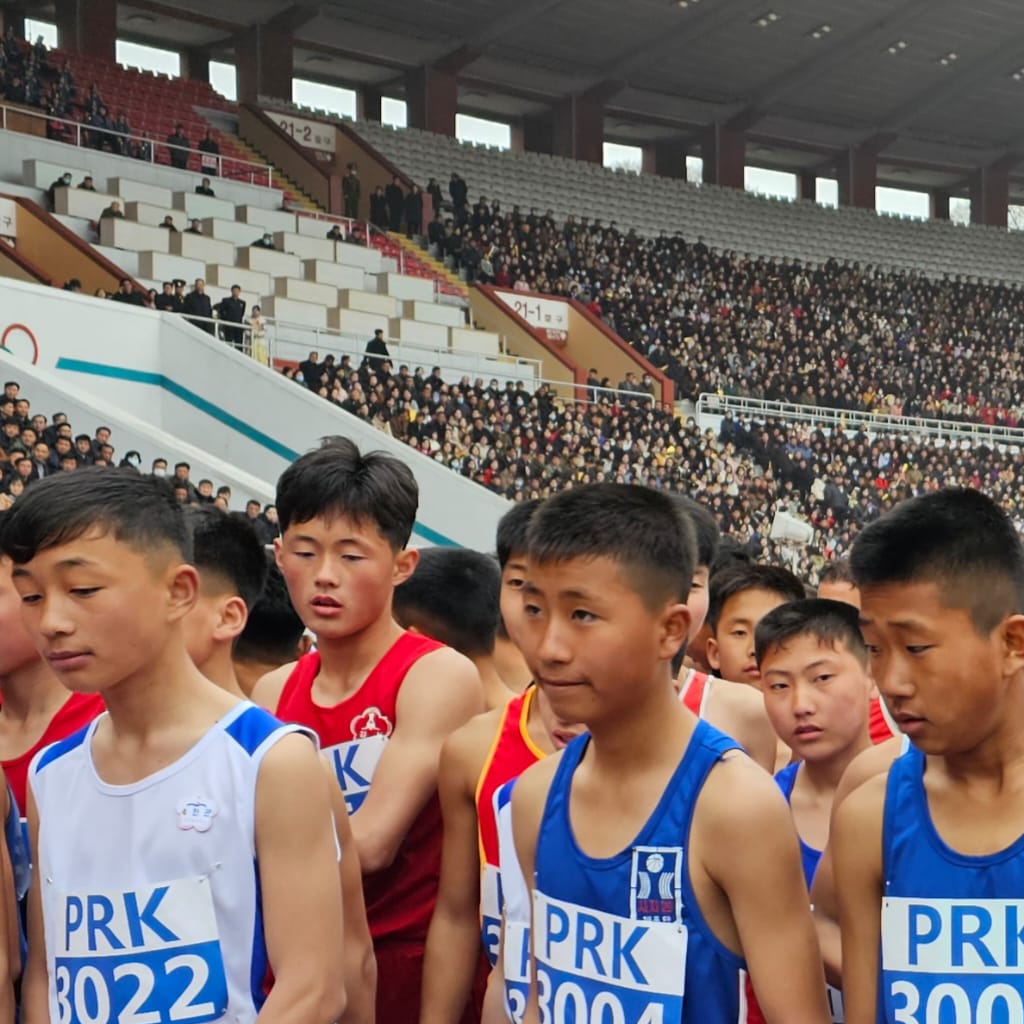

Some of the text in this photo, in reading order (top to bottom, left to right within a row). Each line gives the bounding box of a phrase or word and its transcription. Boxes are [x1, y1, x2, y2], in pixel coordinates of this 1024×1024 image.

[280, 120, 311, 142] 21-2
[514, 300, 541, 321] 21-1
[66, 886, 181, 951] PRK
[546, 903, 650, 986] PRK
